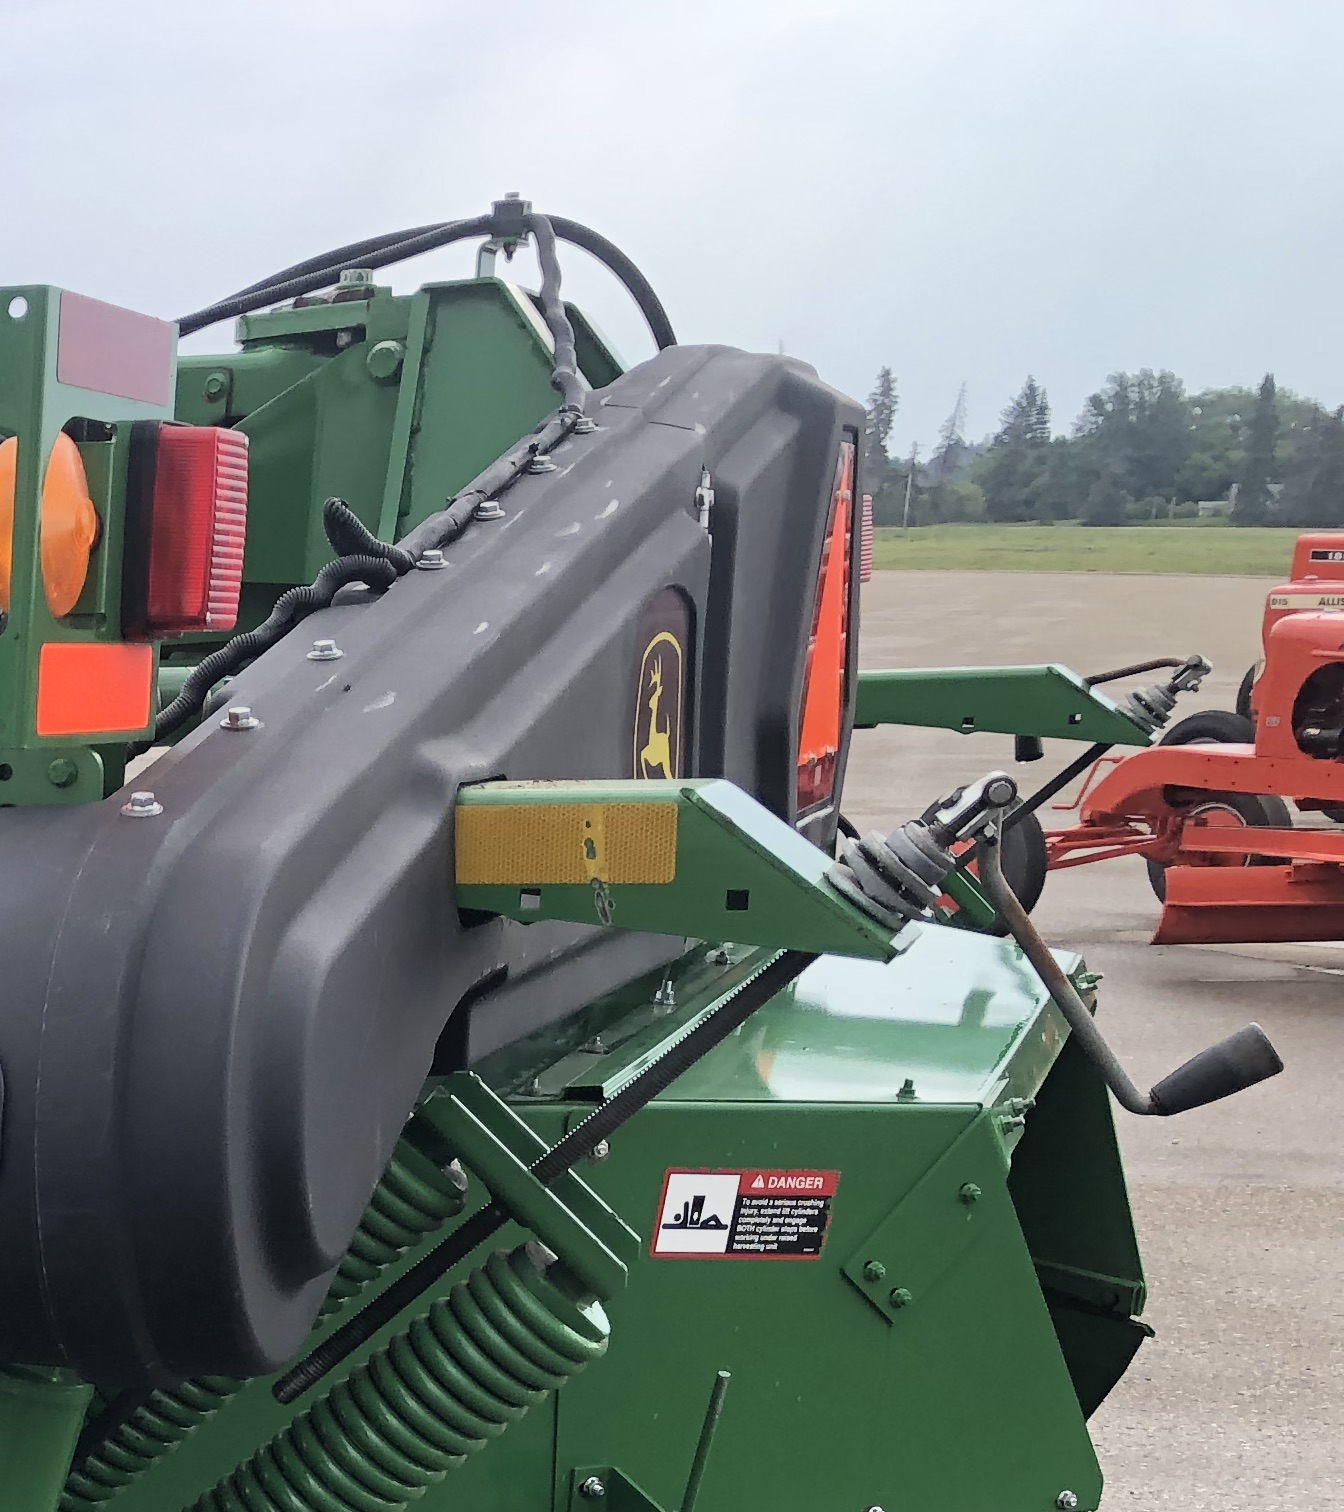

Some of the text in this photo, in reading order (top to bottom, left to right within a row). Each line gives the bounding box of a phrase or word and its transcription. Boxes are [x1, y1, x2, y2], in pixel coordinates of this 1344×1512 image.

[768, 1176, 824, 1189] DANGER
[798, 1199, 825, 1208] crushing
[791, 1207, 819, 1216] cylinders
[738, 1216, 771, 1224] completely
[784, 1217, 808, 1226] engage
[755, 1225, 780, 1234] cylinder
[732, 1243, 765, 1252] harvesting
